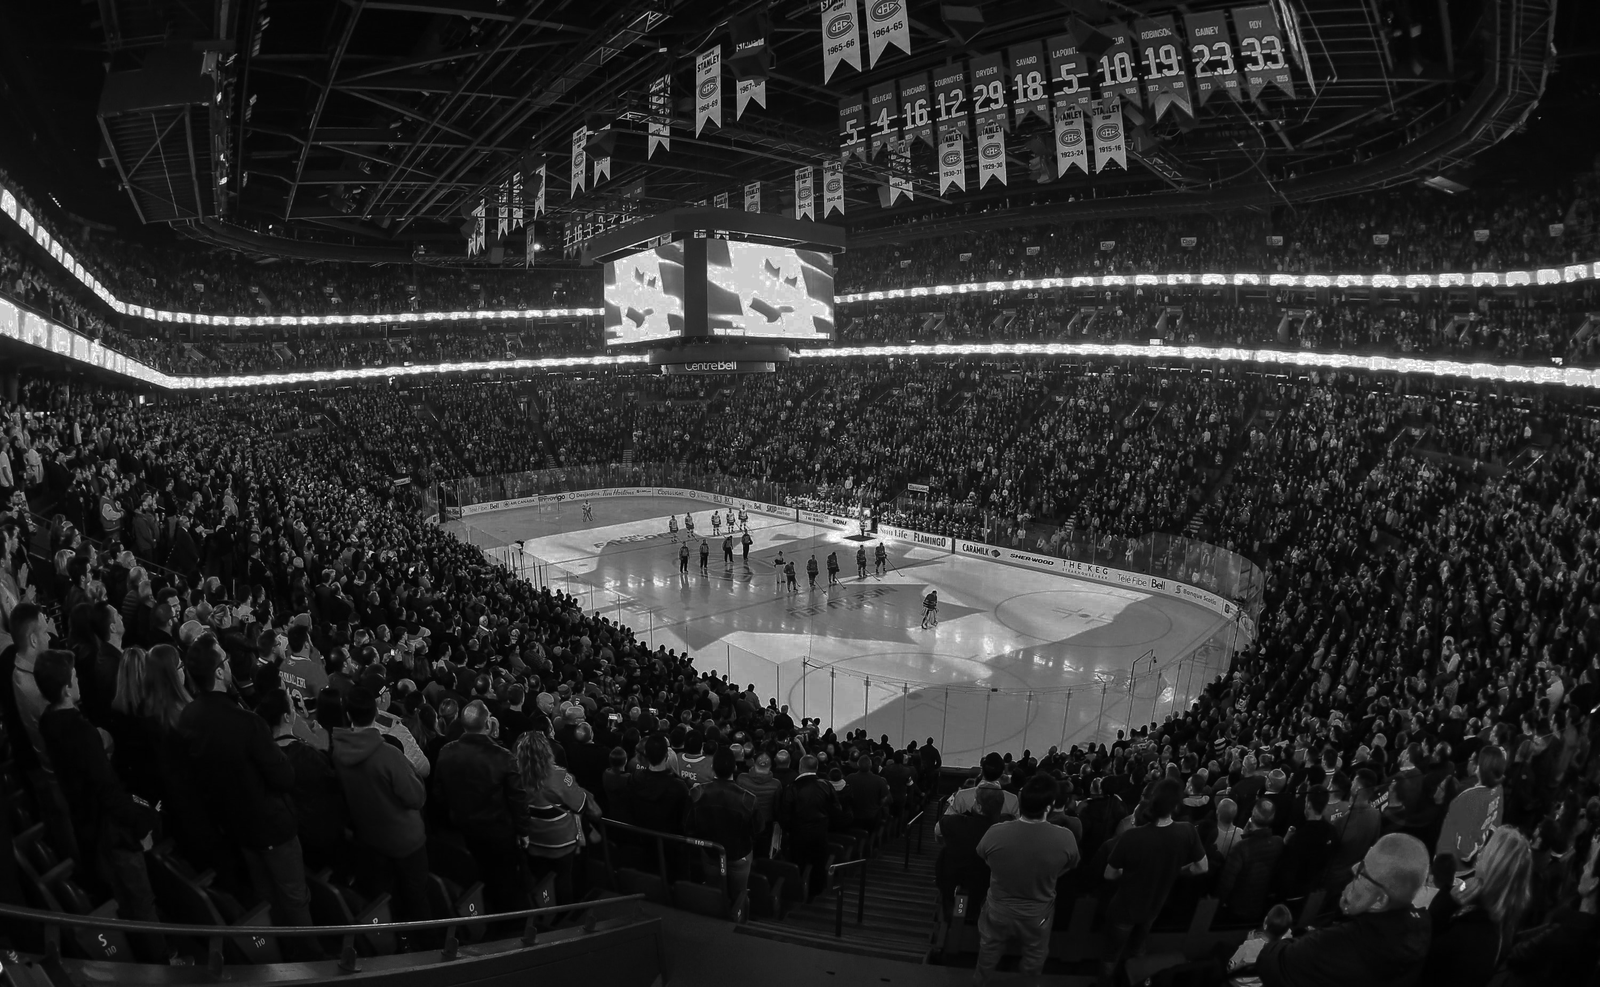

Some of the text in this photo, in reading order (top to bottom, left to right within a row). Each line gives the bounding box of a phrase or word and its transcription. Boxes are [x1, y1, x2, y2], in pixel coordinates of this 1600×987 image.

[872, 21, 904, 39] 1964-65
[1195, 26, 1218, 36] GAINEY
[1249, 20, 1262, 29] ROY
[1141, 28, 1171, 39] ROBINSON
[827, 39, 855, 55] 1965-66
[1052, 47, 1078, 58] LAPOINT
[1242, 36, 1284, 71] 33
[698, 54, 719, 72] STANLEY
[1016, 56, 1037, 66] SAVARD
[1145, 44, 1179, 79] 19
[1193, 42, 1234, 77] 23
[976, 66, 997, 77] DRYDEN
[1100, 52, 1132, 86] 10
[935, 74, 963, 87] COURNOYER
[1061, 63, 1078, 94] 5
[1014, 71, 1043, 103] 18
[872, 92, 892, 105] BÉLIVEAU
[974, 81, 1004, 114] 29
[938, 89, 964, 121] 12
[1092, 104, 1119, 116] STALEY
[877, 108, 890, 135] 4
[903, 99, 928, 131] 16
[846, 119, 857, 146] 5
[1061, 150, 1083, 158] 1923-24
[1099, 145, 1121, 153] 1915-16
[894, 529, 908, 539] Life
[914, 532, 946, 548] FLAMINGO
[962, 543, 989, 556] CARAMILK
[1063, 560, 1108, 575] THE KEG
[1117, 573, 1167, 591] Télé Fibe Bell
[681, 770, 697, 781] PRICE
[98, 933, 108, 947] S
[254, 938, 267, 949] 110
[105, 945, 117, 957] 110
